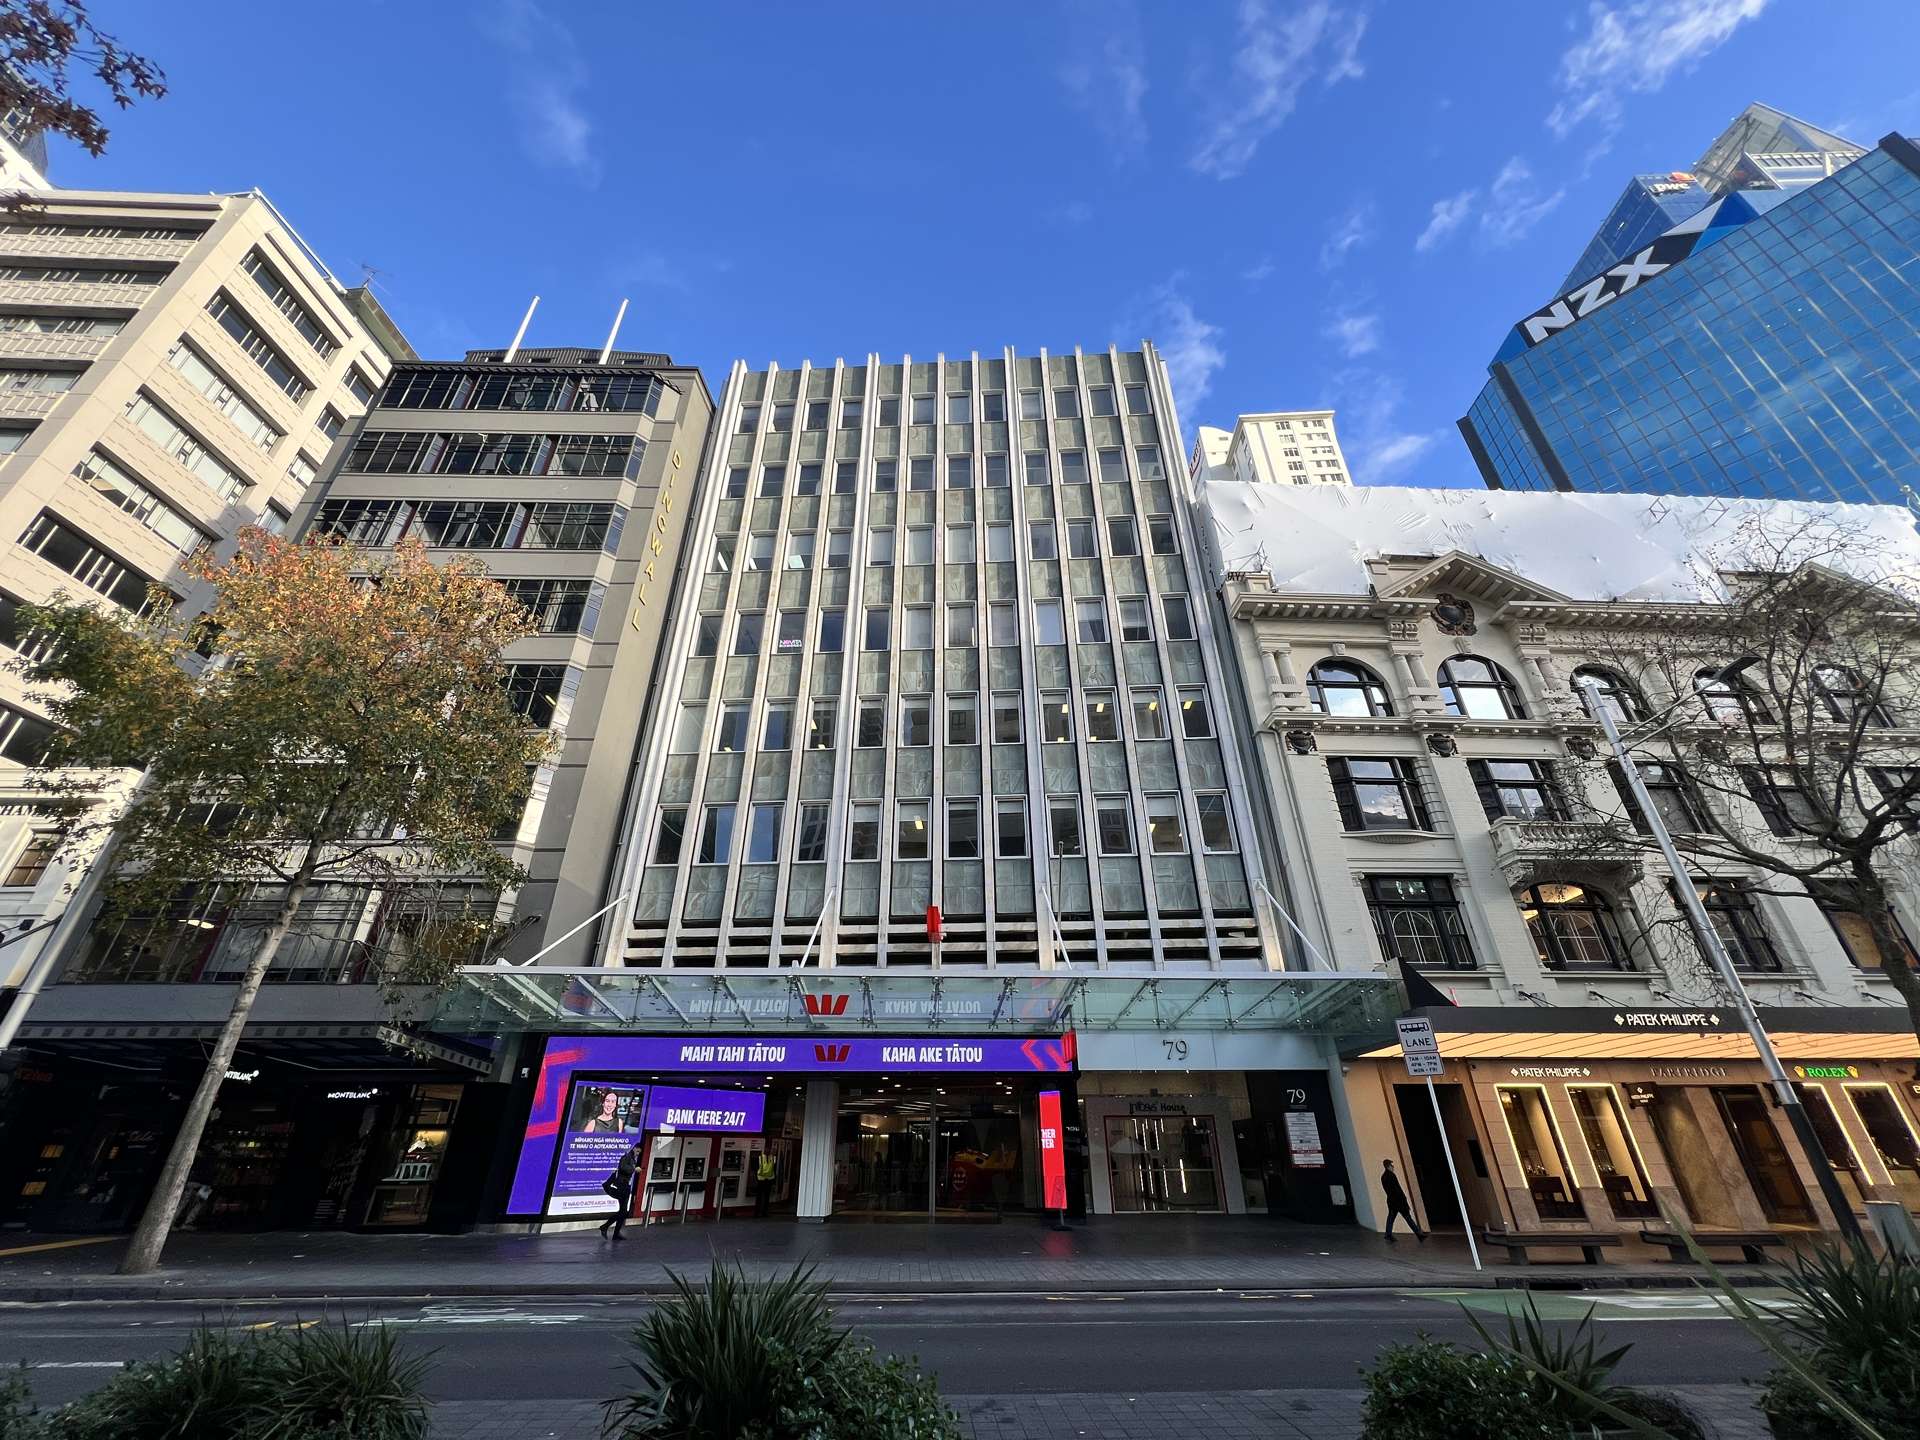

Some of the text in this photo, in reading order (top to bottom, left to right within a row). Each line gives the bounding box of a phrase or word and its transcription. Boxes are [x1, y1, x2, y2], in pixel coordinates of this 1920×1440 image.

[1524, 245, 1671, 343] NZX
[631, 449, 682, 632] DINGWALL
[1626, 1013, 1709, 1026] PATEK PHILIPPE
[1162, 1039, 1187, 1060] 79
[1405, 1037, 1432, 1047] LANE
[680, 1042, 786, 1062] MAHI TAHI TĀTOU
[882, 1043, 983, 1062] KAHA AKE TĀTOU
[224, 1070, 252, 1081] NTBLANC
[1520, 1067, 1582, 1077] PATEK PHILIPPE
[1806, 1067, 1848, 1078] ROLEX
[327, 1091, 372, 1099] MONTBLANC
[1286, 1088, 1306, 1104] 79
[666, 1108, 747, 1126] BANK HERE 24/7
